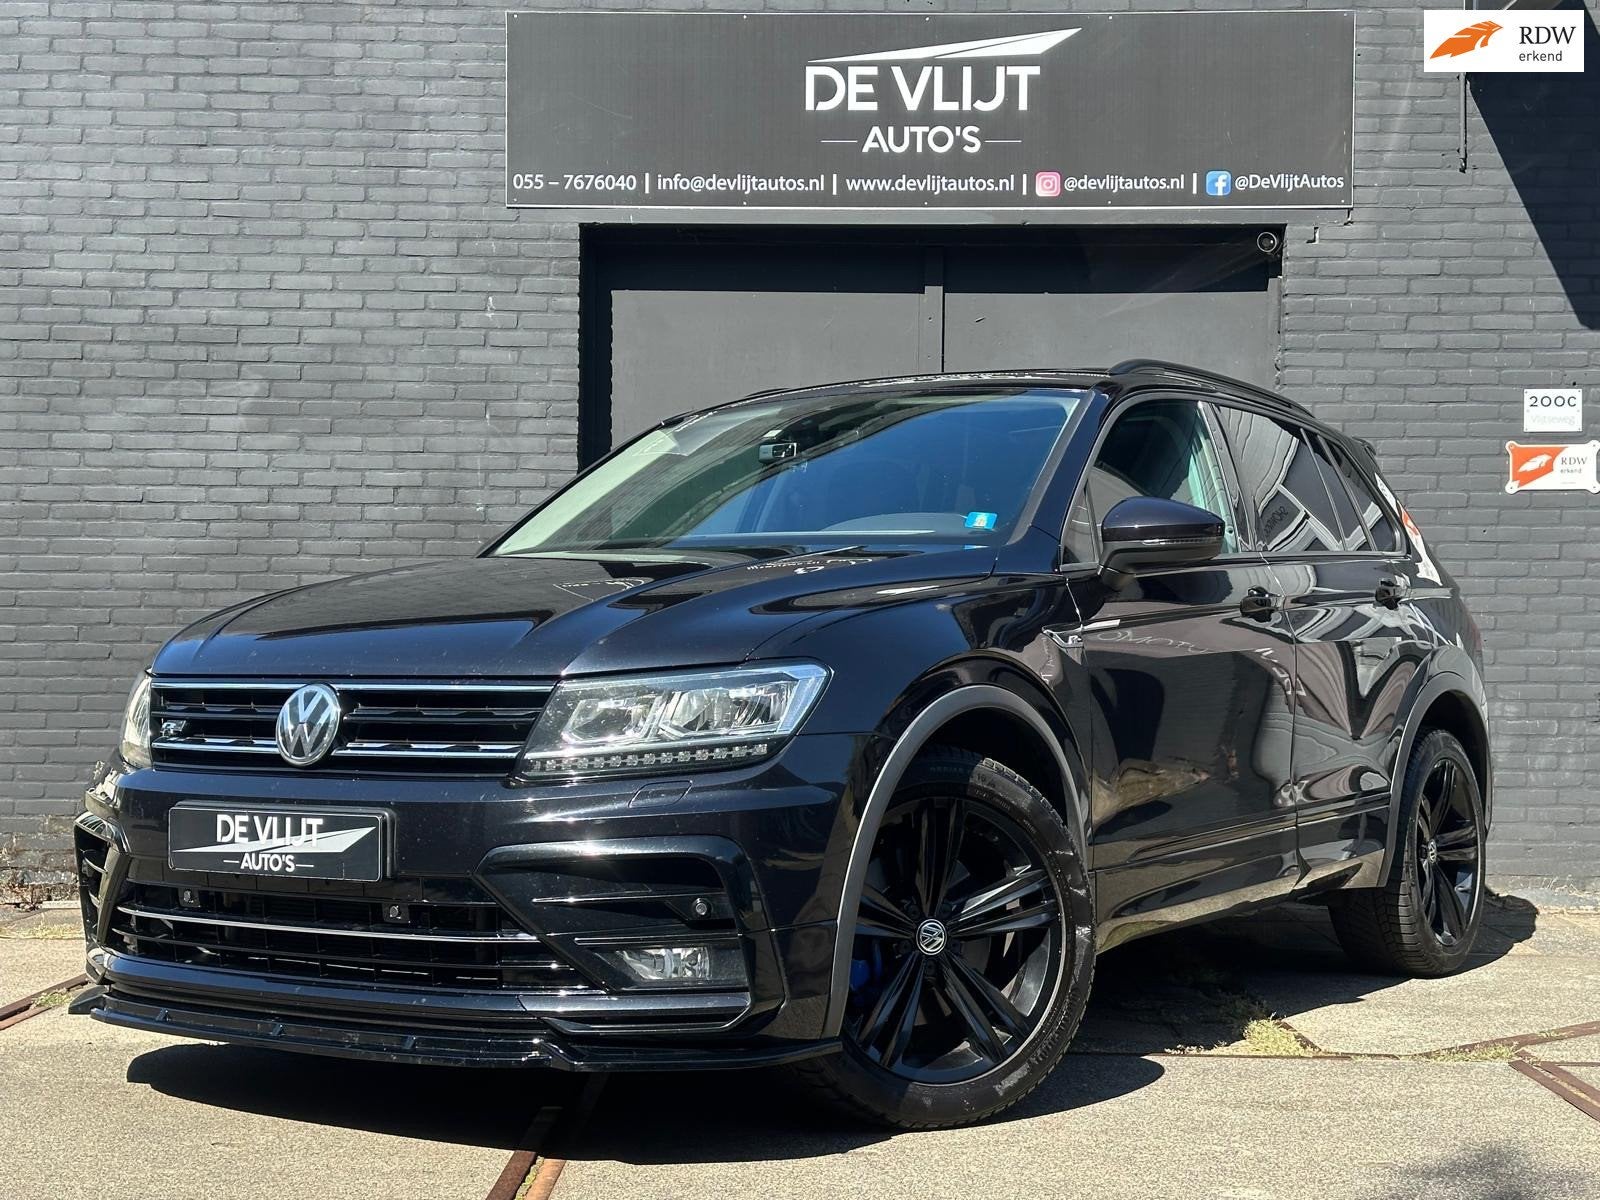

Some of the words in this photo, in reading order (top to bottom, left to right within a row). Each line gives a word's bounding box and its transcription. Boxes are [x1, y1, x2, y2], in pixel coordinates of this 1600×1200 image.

[805, 65, 879, 111] DE
[890, 64, 1041, 112] VLIJT
[861, 125, 982, 154] AUTO'S
[512, 173, 545, 191] 055
[563, 173, 638, 192] 7676040
[657, 173, 825, 195] info@devlijtautos.nl
[845, 173, 1015, 196] www.devlijtautos.nl
[1063, 173, 1185, 194] @devlijtautos.nl
[1234, 173, 1345, 193] @DeVlijtAutos
[1529, 395, 1577, 408] 200C
[1560, 456, 1588, 466] RDW
[216, 813, 251, 844] DE
[253, 815, 324, 848] VLIJT
[239, 852, 297, 873] AUTO'S
